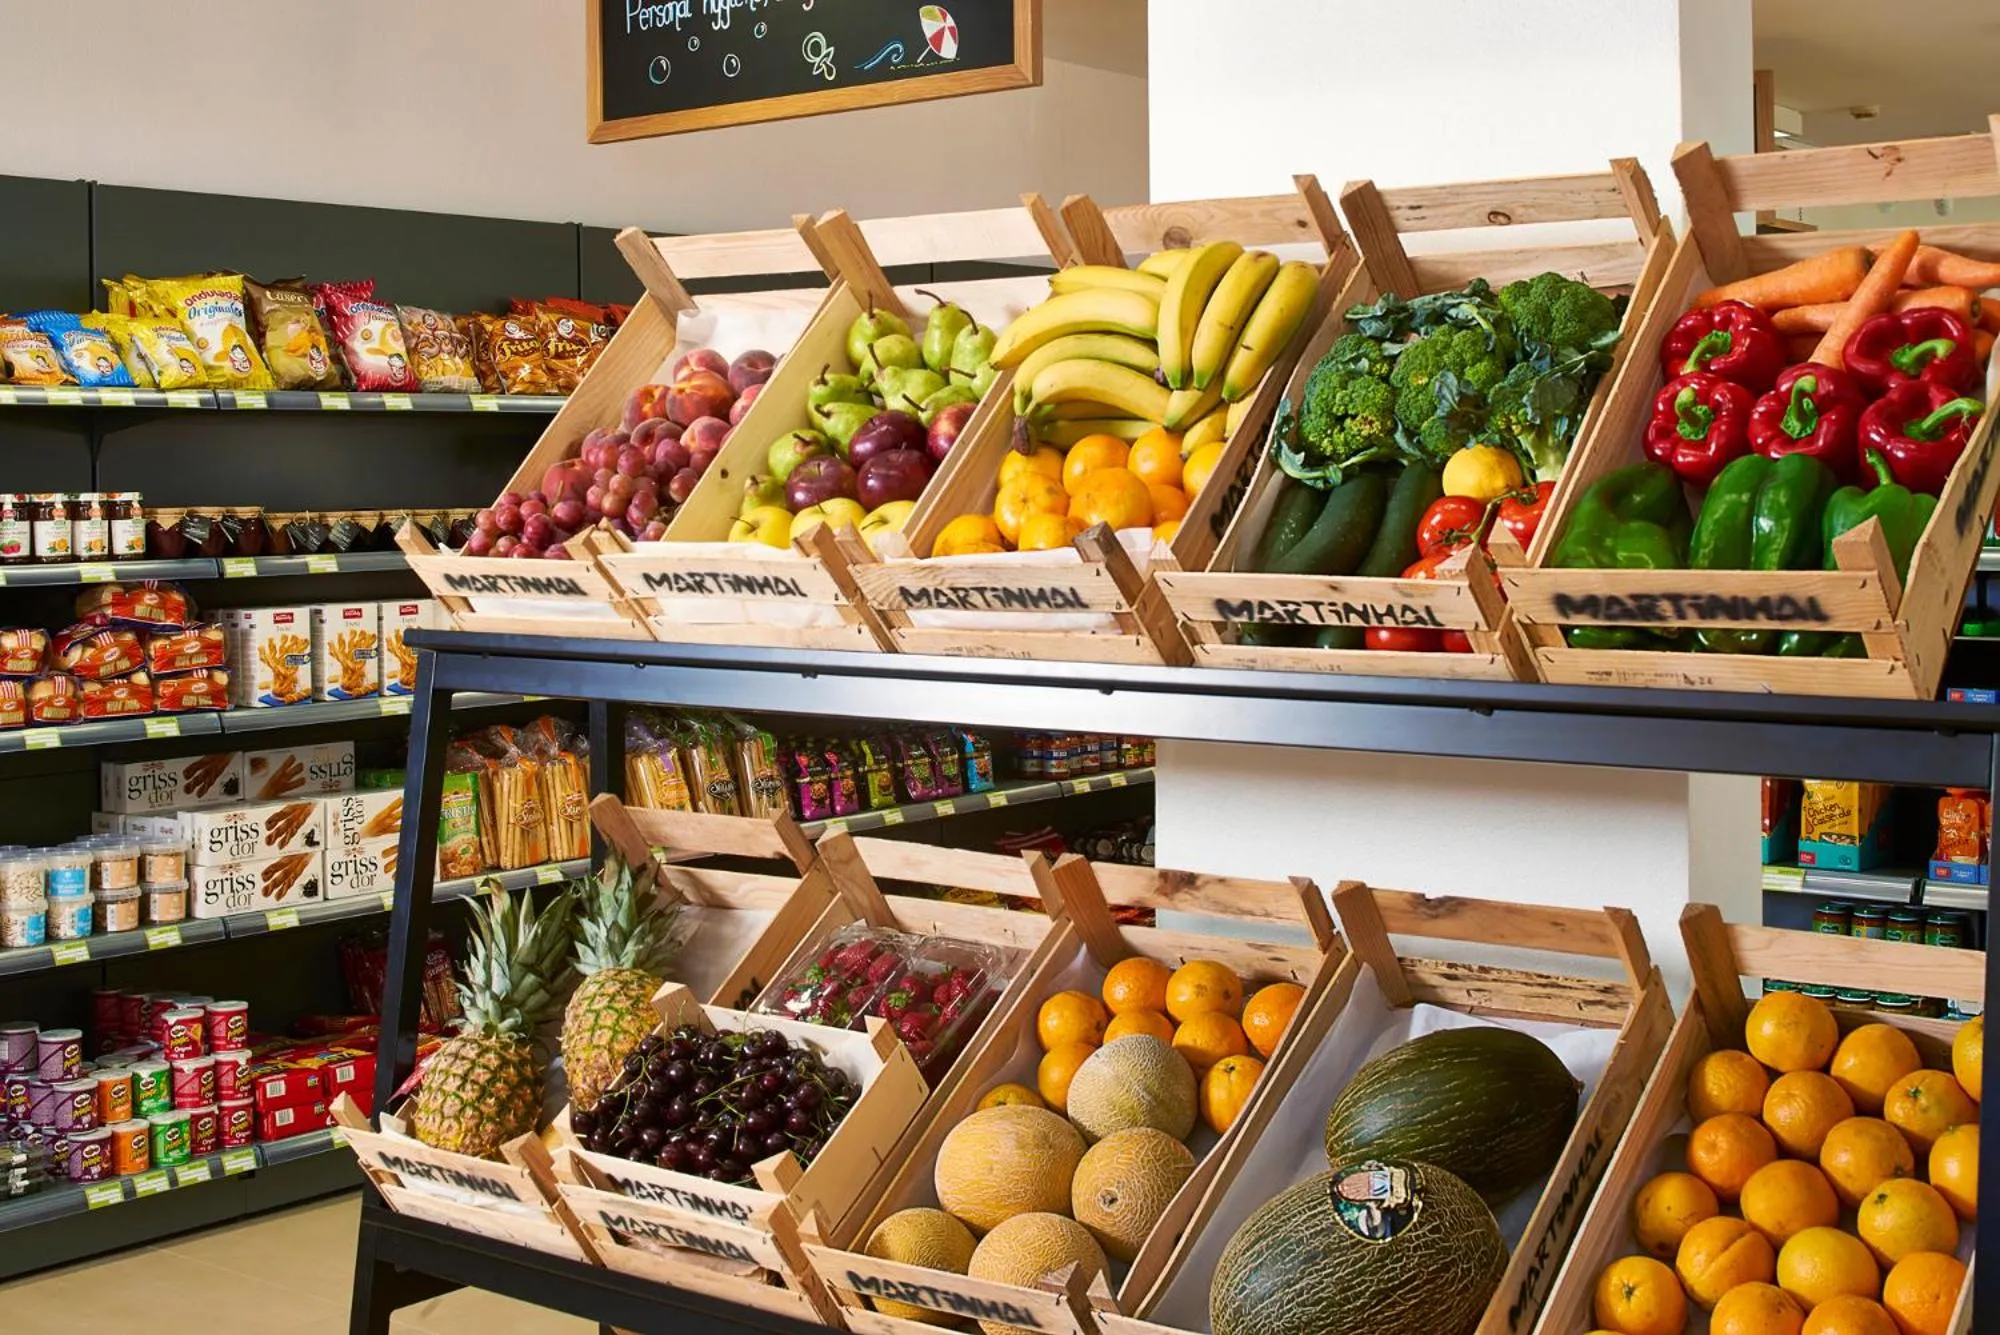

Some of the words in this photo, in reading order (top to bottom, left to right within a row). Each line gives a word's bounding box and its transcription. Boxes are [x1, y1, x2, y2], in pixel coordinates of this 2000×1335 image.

[626, 0, 693, 34] Personal
[128, 768, 178, 801] griss
[149, 786, 176, 803] dor
[341, 796, 361, 846] griss
[1808, 802, 1840, 817] Chicken
[208, 819, 260, 852] griss
[229, 839, 258, 857] dor
[329, 853, 379, 886] griss
[350, 872, 377, 889] dor
[204, 871, 256, 905] griss
[225, 890, 255, 909] dor
